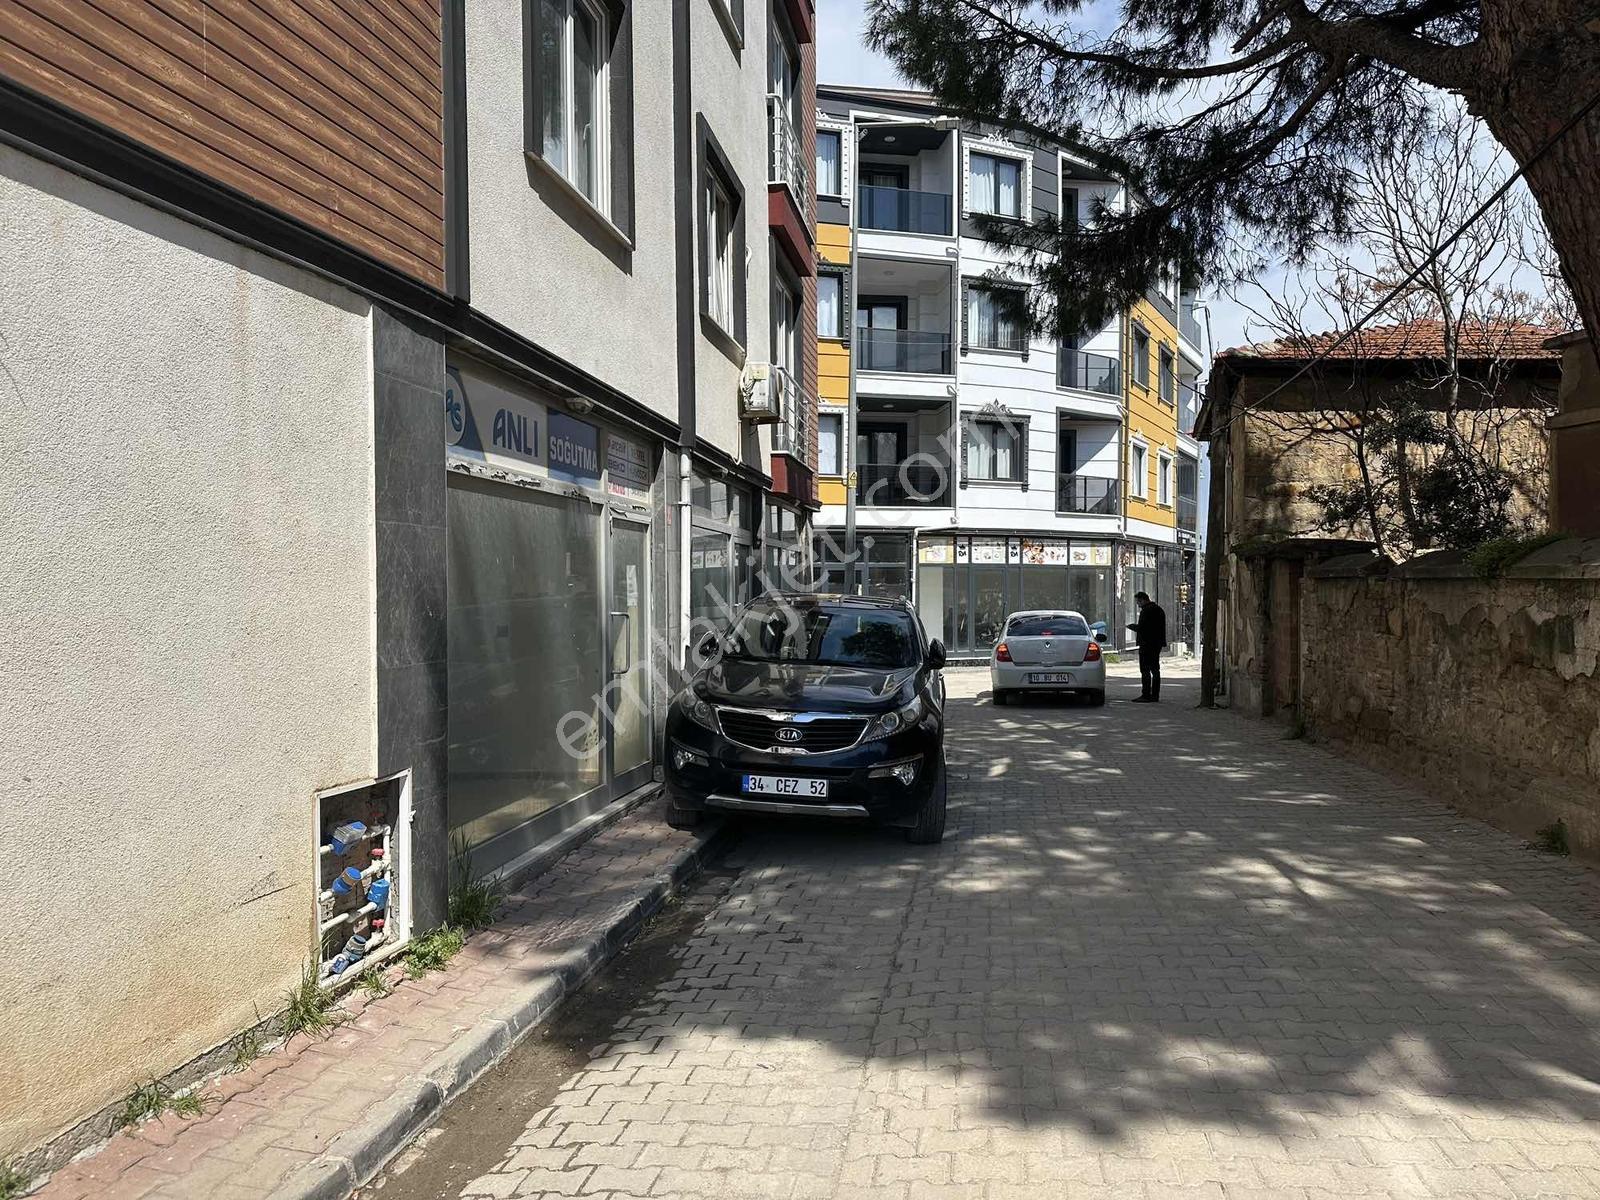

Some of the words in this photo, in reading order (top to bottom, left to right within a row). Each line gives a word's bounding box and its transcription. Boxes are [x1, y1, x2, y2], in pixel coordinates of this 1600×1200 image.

[493, 408, 538, 457] ANLI
[550, 435, 598, 473] SOĞUTMA
[779, 729, 798, 739] KIA
[750, 777, 764, 791] 34
[776, 778, 799, 794] CEZ
[810, 780, 825, 795] 52
